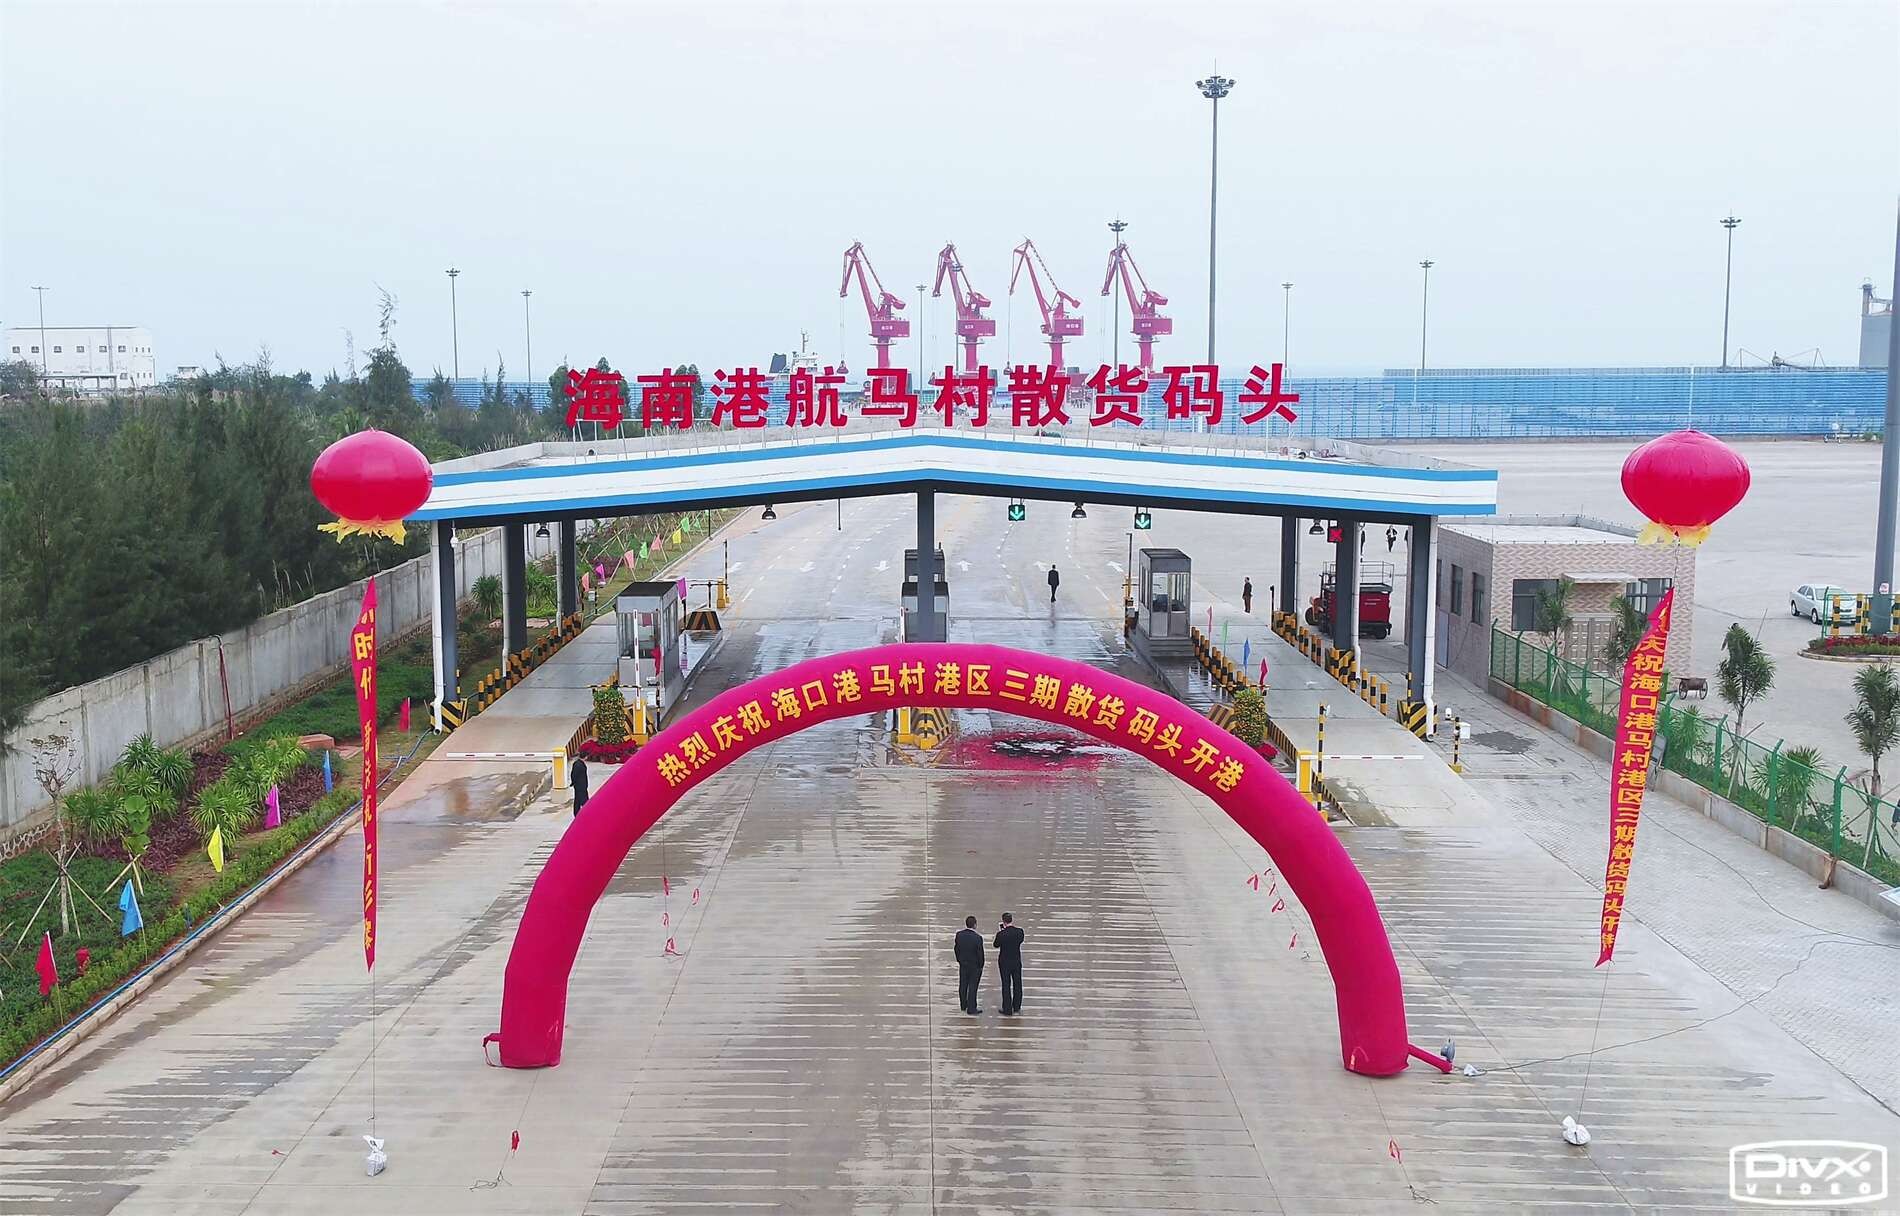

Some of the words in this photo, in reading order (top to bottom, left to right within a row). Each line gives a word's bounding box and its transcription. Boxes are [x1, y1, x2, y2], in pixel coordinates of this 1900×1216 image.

[564, 363, 1301, 429] 海南港航马村散货码头
[657, 662, 1245, 792] 热烈庆祝海口港马村港区三期散货码头开港
